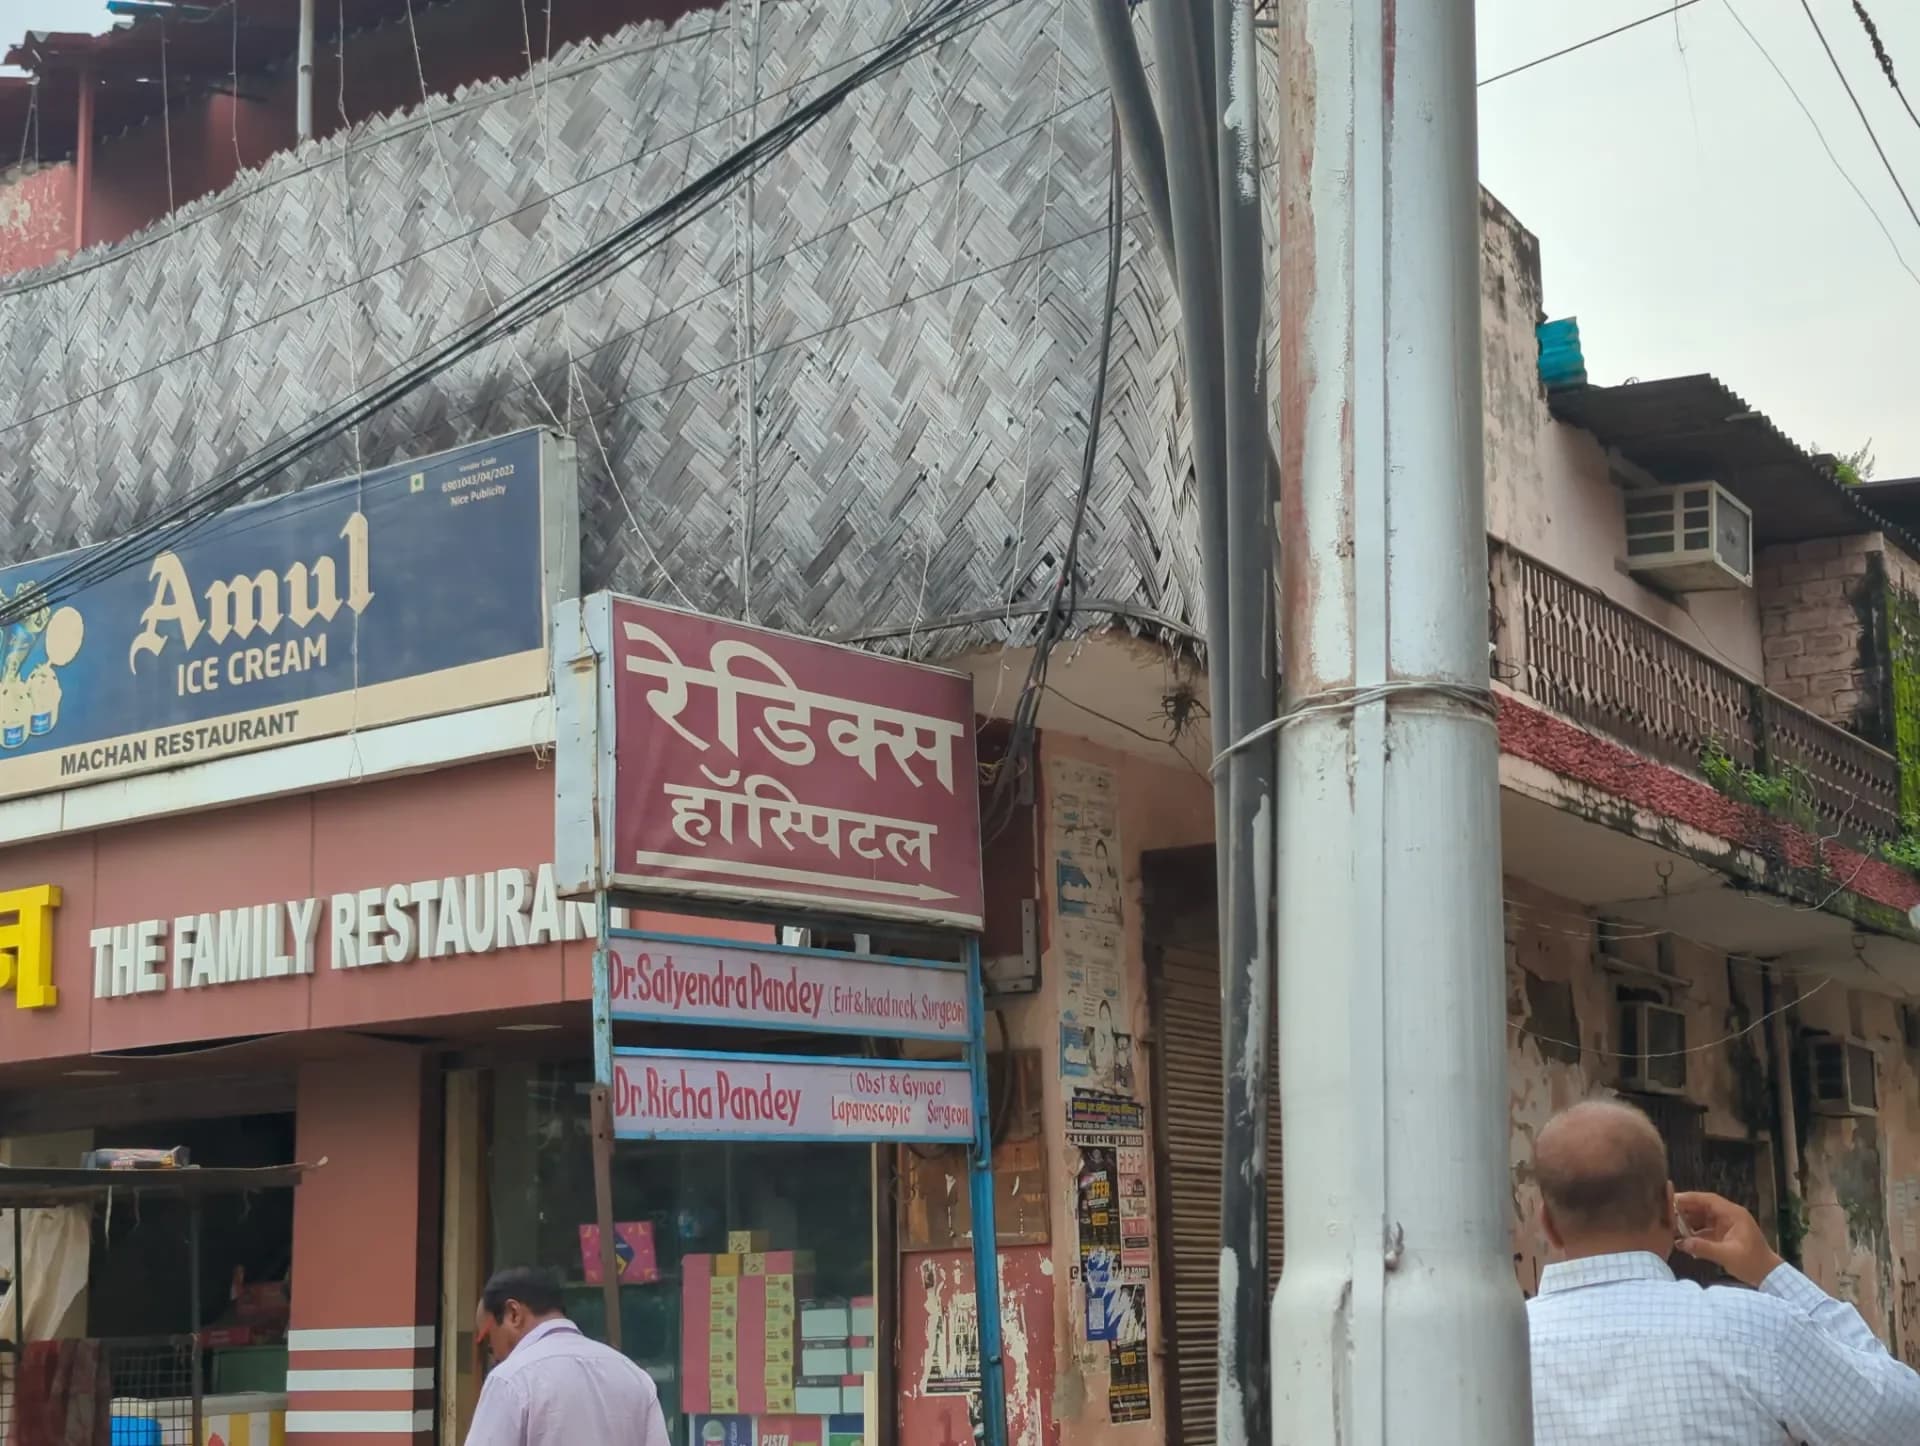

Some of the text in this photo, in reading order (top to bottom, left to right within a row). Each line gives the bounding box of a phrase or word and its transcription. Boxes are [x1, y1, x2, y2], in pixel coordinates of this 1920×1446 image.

[470, 484, 506, 502] Publicity
[130, 511, 376, 675] Amul
[177, 633, 328, 697] ICE CREAM
[623, 621, 965, 796] रेडिक्स
[61, 709, 300, 777] MACHAN RESTAURANT
[664, 764, 939, 873] हॉस्पिटल
[90, 863, 629, 999] THE FAMILY RESTAURAN
[750, 962, 824, 1020] Pandey
[717, 1069, 802, 1127] Pandey
[831, 1096, 970, 1130] Laparoscopic Surgeon
[889, 1075, 900, 1095] &
